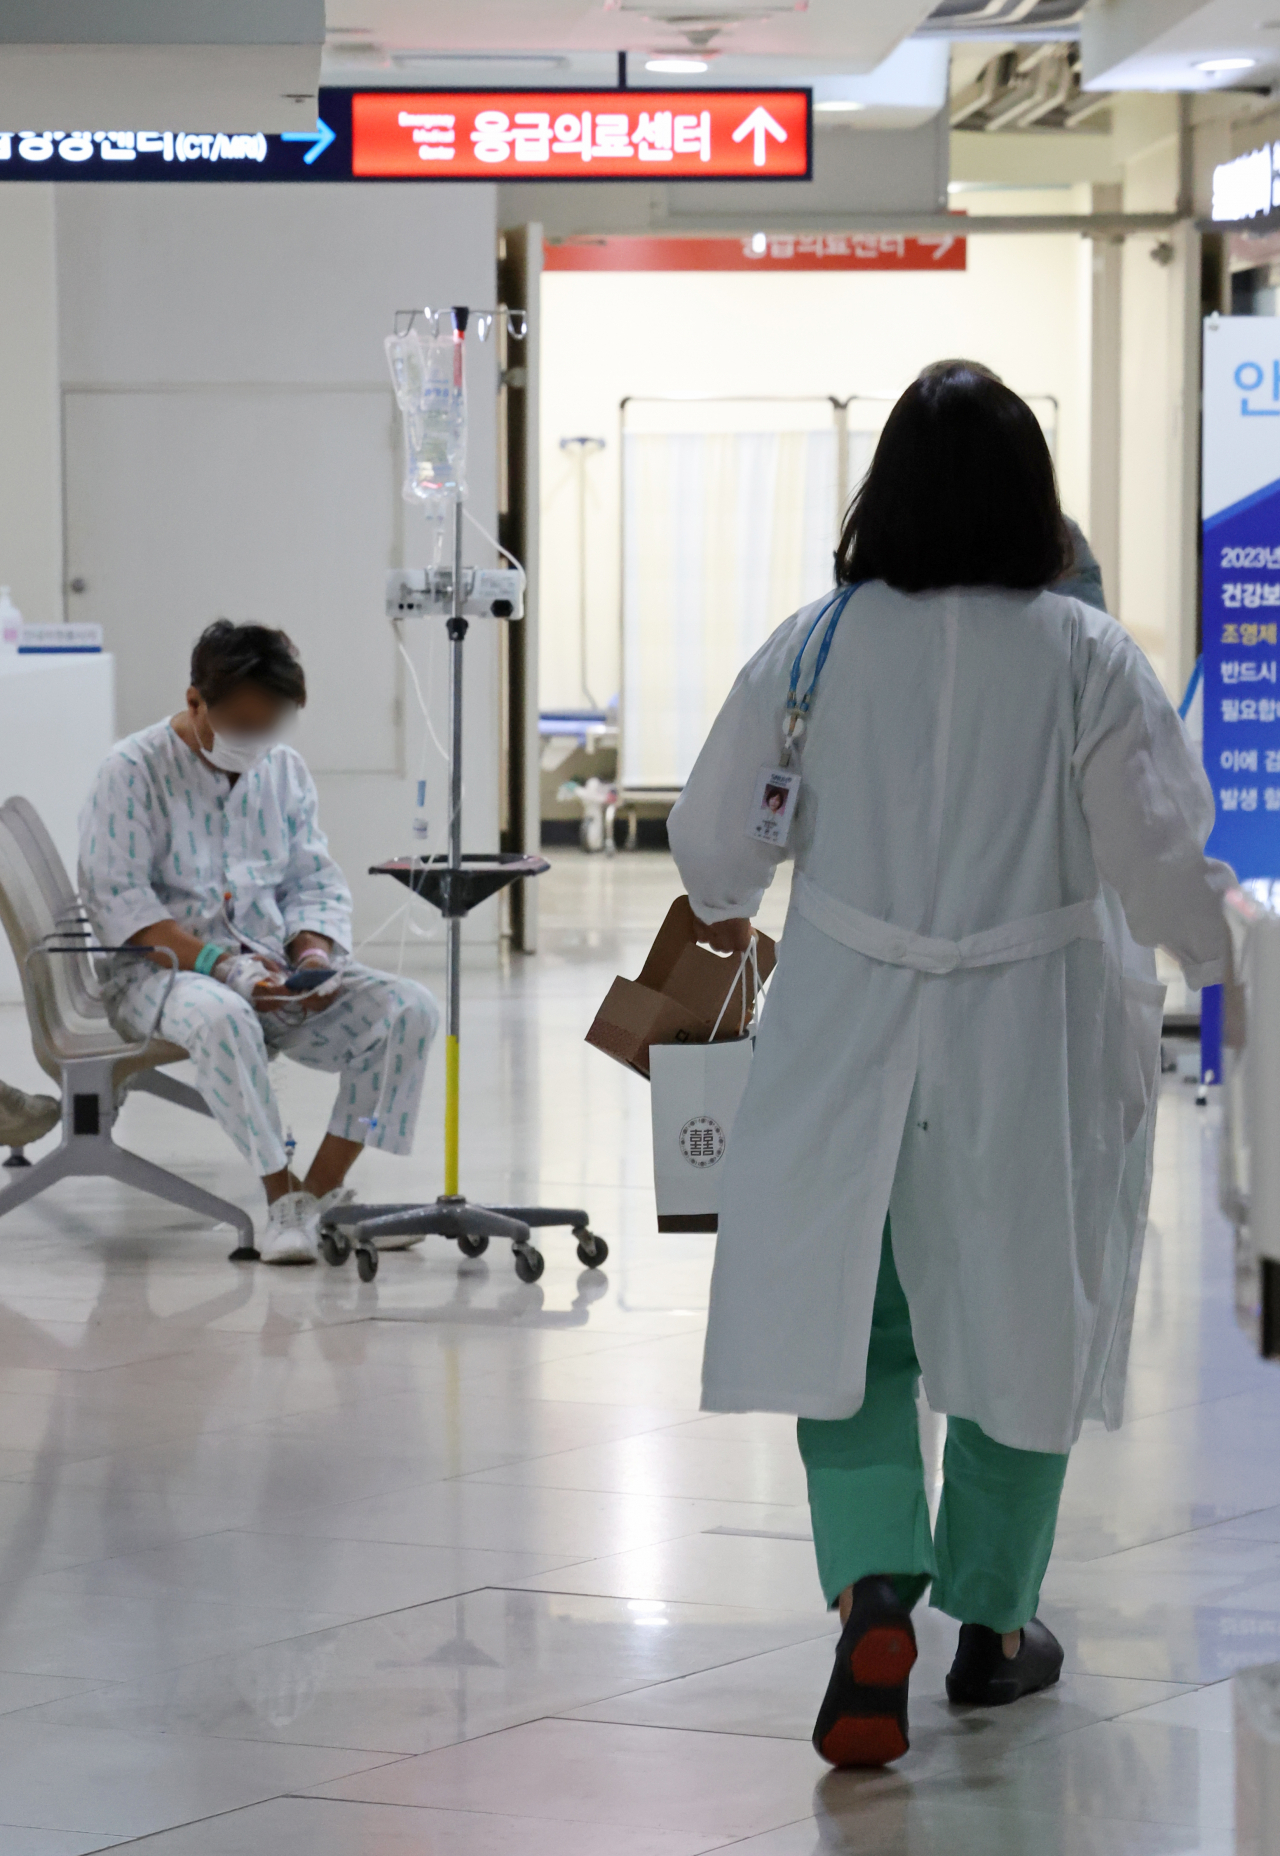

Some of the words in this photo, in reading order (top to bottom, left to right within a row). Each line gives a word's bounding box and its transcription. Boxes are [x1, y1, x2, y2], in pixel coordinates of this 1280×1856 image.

[471, 110, 711, 163] 응급의료센터
[1220, 661, 1277, 684] 반드시
[1221, 698, 1280, 722] 필요합
[1220, 749, 1258, 772] 이에
